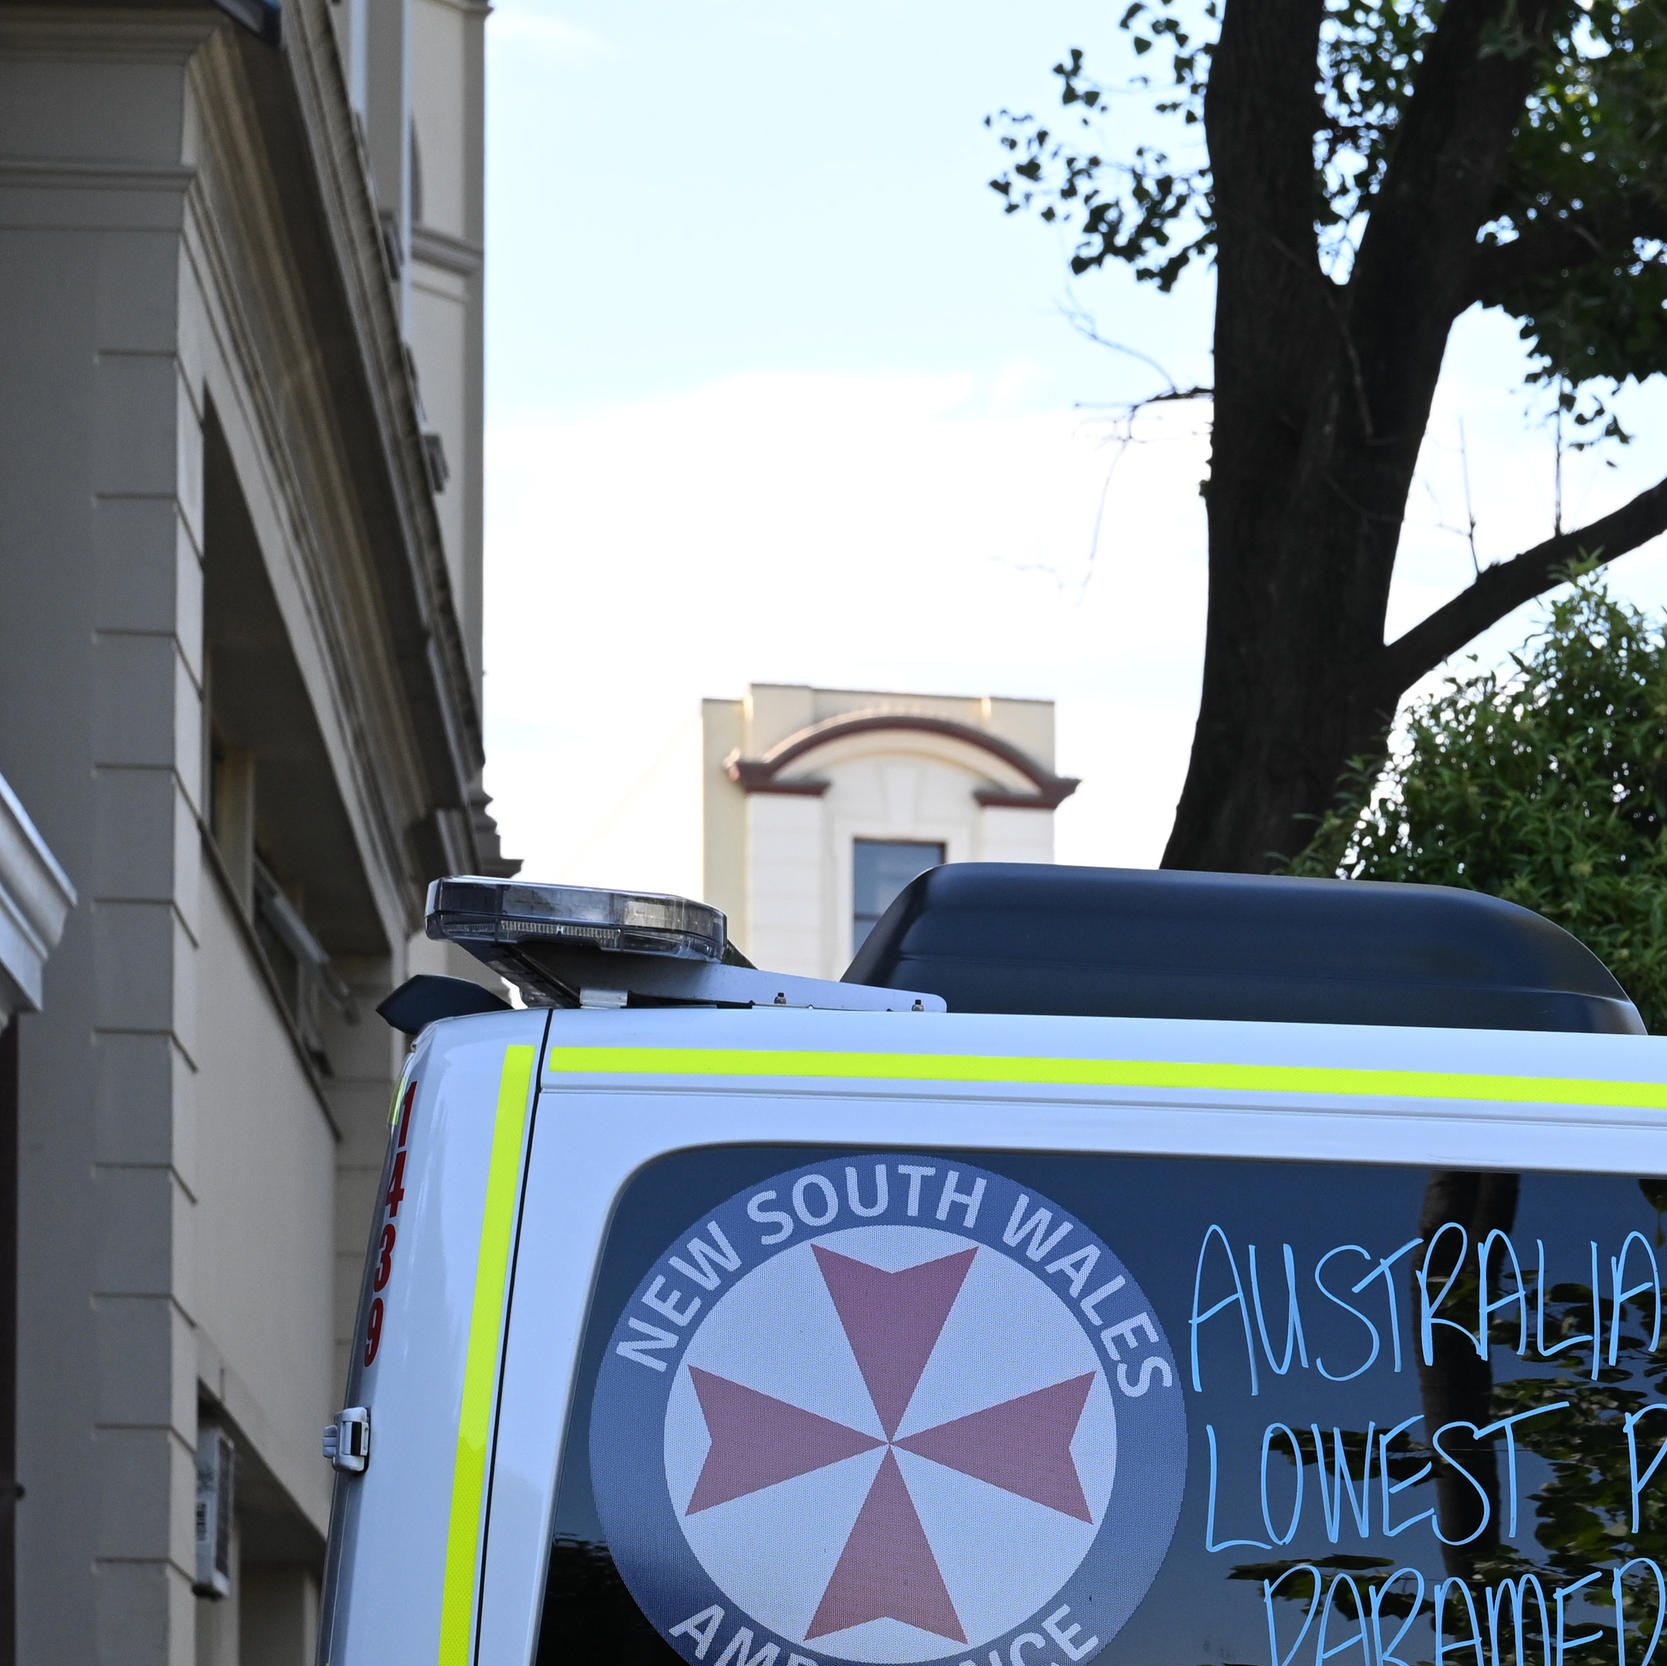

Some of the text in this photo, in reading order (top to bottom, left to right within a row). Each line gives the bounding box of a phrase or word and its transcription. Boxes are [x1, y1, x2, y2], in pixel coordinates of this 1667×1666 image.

[364, 1081, 418, 1368] 1439
[616, 1163, 1173, 1398] NEW SOUTH WALES
[1205, 1400, 1570, 1552] LOWEST
